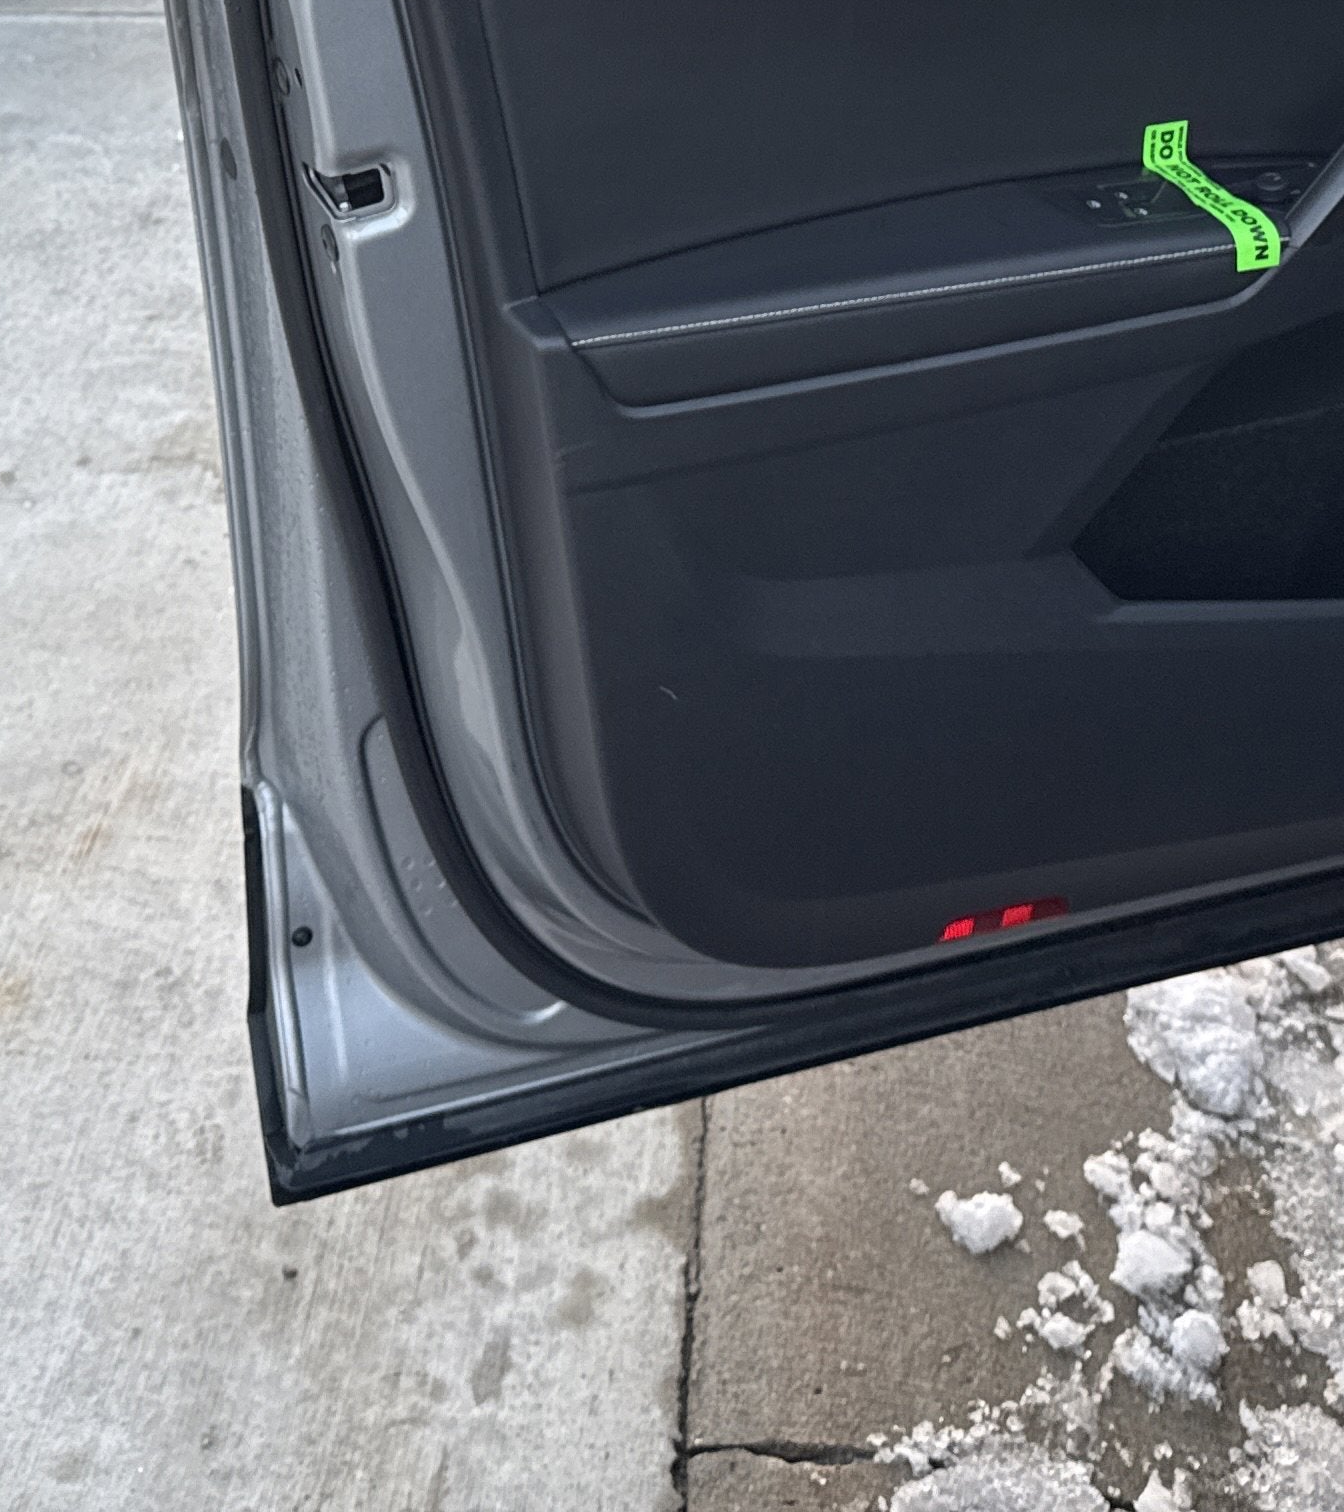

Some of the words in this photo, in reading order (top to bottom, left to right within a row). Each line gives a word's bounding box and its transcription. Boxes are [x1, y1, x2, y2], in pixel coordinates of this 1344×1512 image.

[1159, 130, 1175, 160] DO
[1166, 164, 1201, 185] NOT
[1194, 186, 1234, 208] ROLL
[1231, 209, 1269, 261] DOWN
